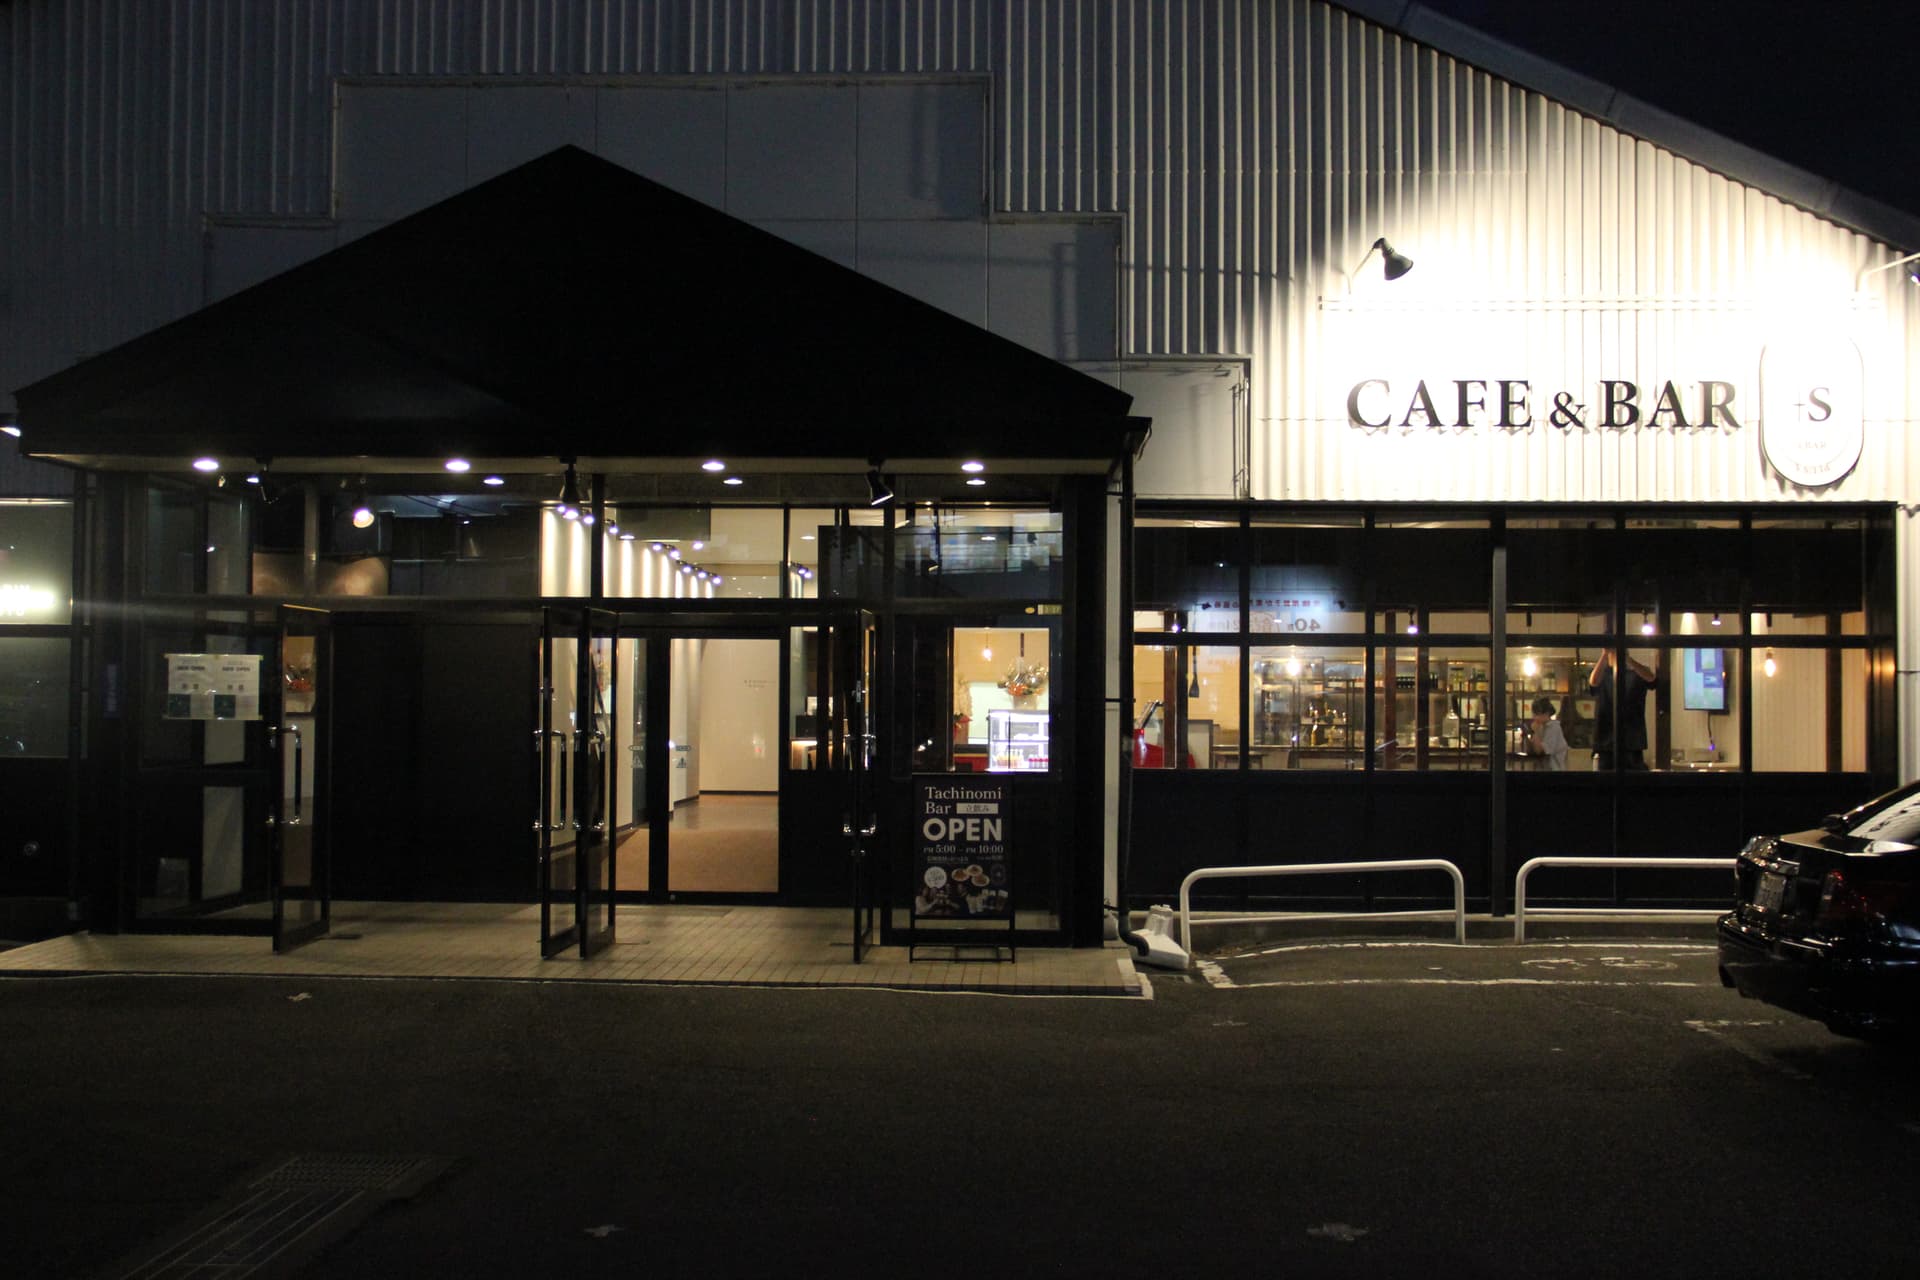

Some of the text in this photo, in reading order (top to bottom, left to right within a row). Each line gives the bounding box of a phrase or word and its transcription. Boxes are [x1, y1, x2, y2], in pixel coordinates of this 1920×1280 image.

[1347, 379, 1742, 428] CAFE & BAR
[924, 786, 1002, 800] Tachinomi
[925, 801, 952, 815] Bar
[923, 818, 1003, 841] OPEN
[935, 844, 956, 854] 5:00
[979, 844, 1004, 854] 10:00
